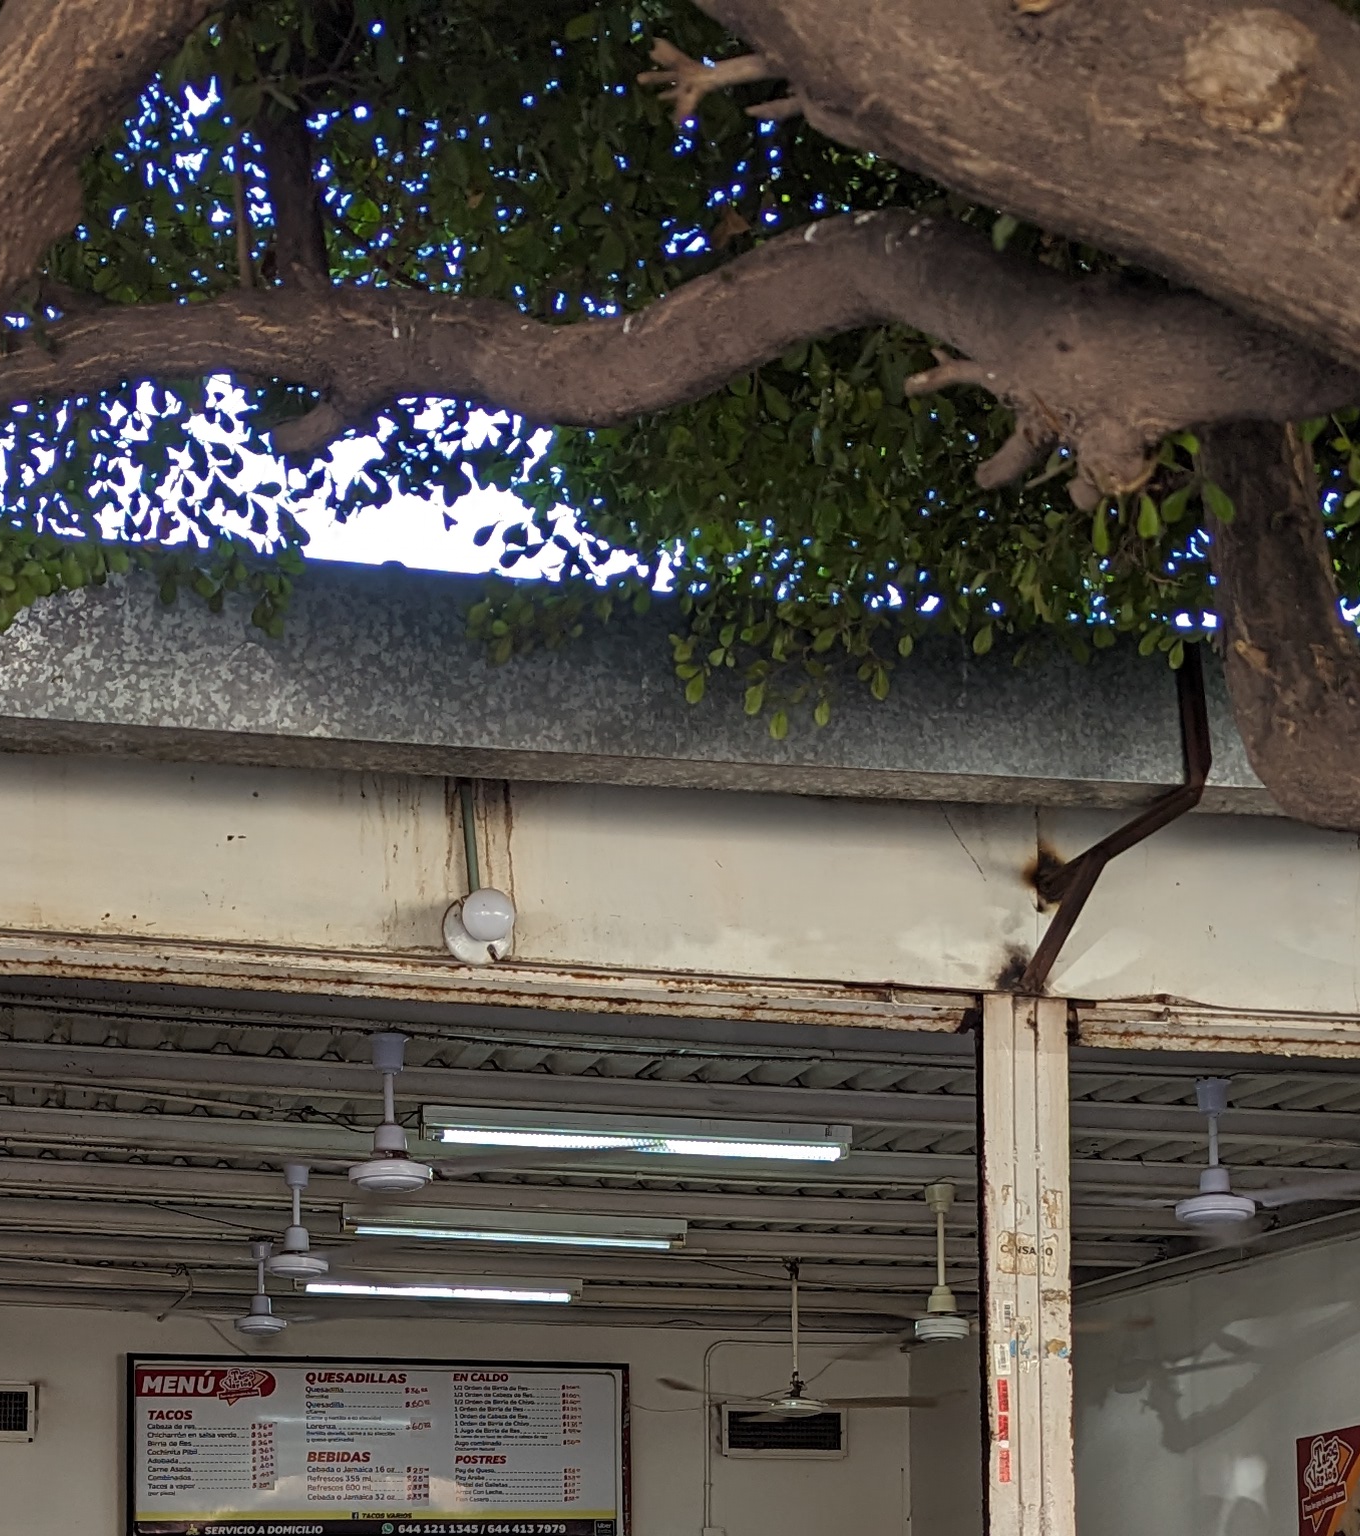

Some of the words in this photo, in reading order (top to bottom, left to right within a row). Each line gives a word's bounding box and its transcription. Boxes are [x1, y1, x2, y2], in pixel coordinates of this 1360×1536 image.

[142, 1370, 215, 1394] MENÚ
[305, 1373, 407, 1384] QUESADILLAS
[148, 1410, 193, 1420] TACOS
[307, 1452, 371, 1462] BEBIDAS
[455, 1455, 507, 1464] POSTRES
[204, 1525, 255, 1535] SERVICIO
[256, 1526, 266, 1535] A
[267, 1525, 323, 1535] DOMICILIO
[398, 1524, 421, 1533] 644
[424, 1524, 446, 1533] 121
[449, 1524, 478, 1534] 1345
[487, 1524, 510, 1534] 644
[512, 1524, 534, 1534] 413
[537, 1524, 566, 1534] 7979
